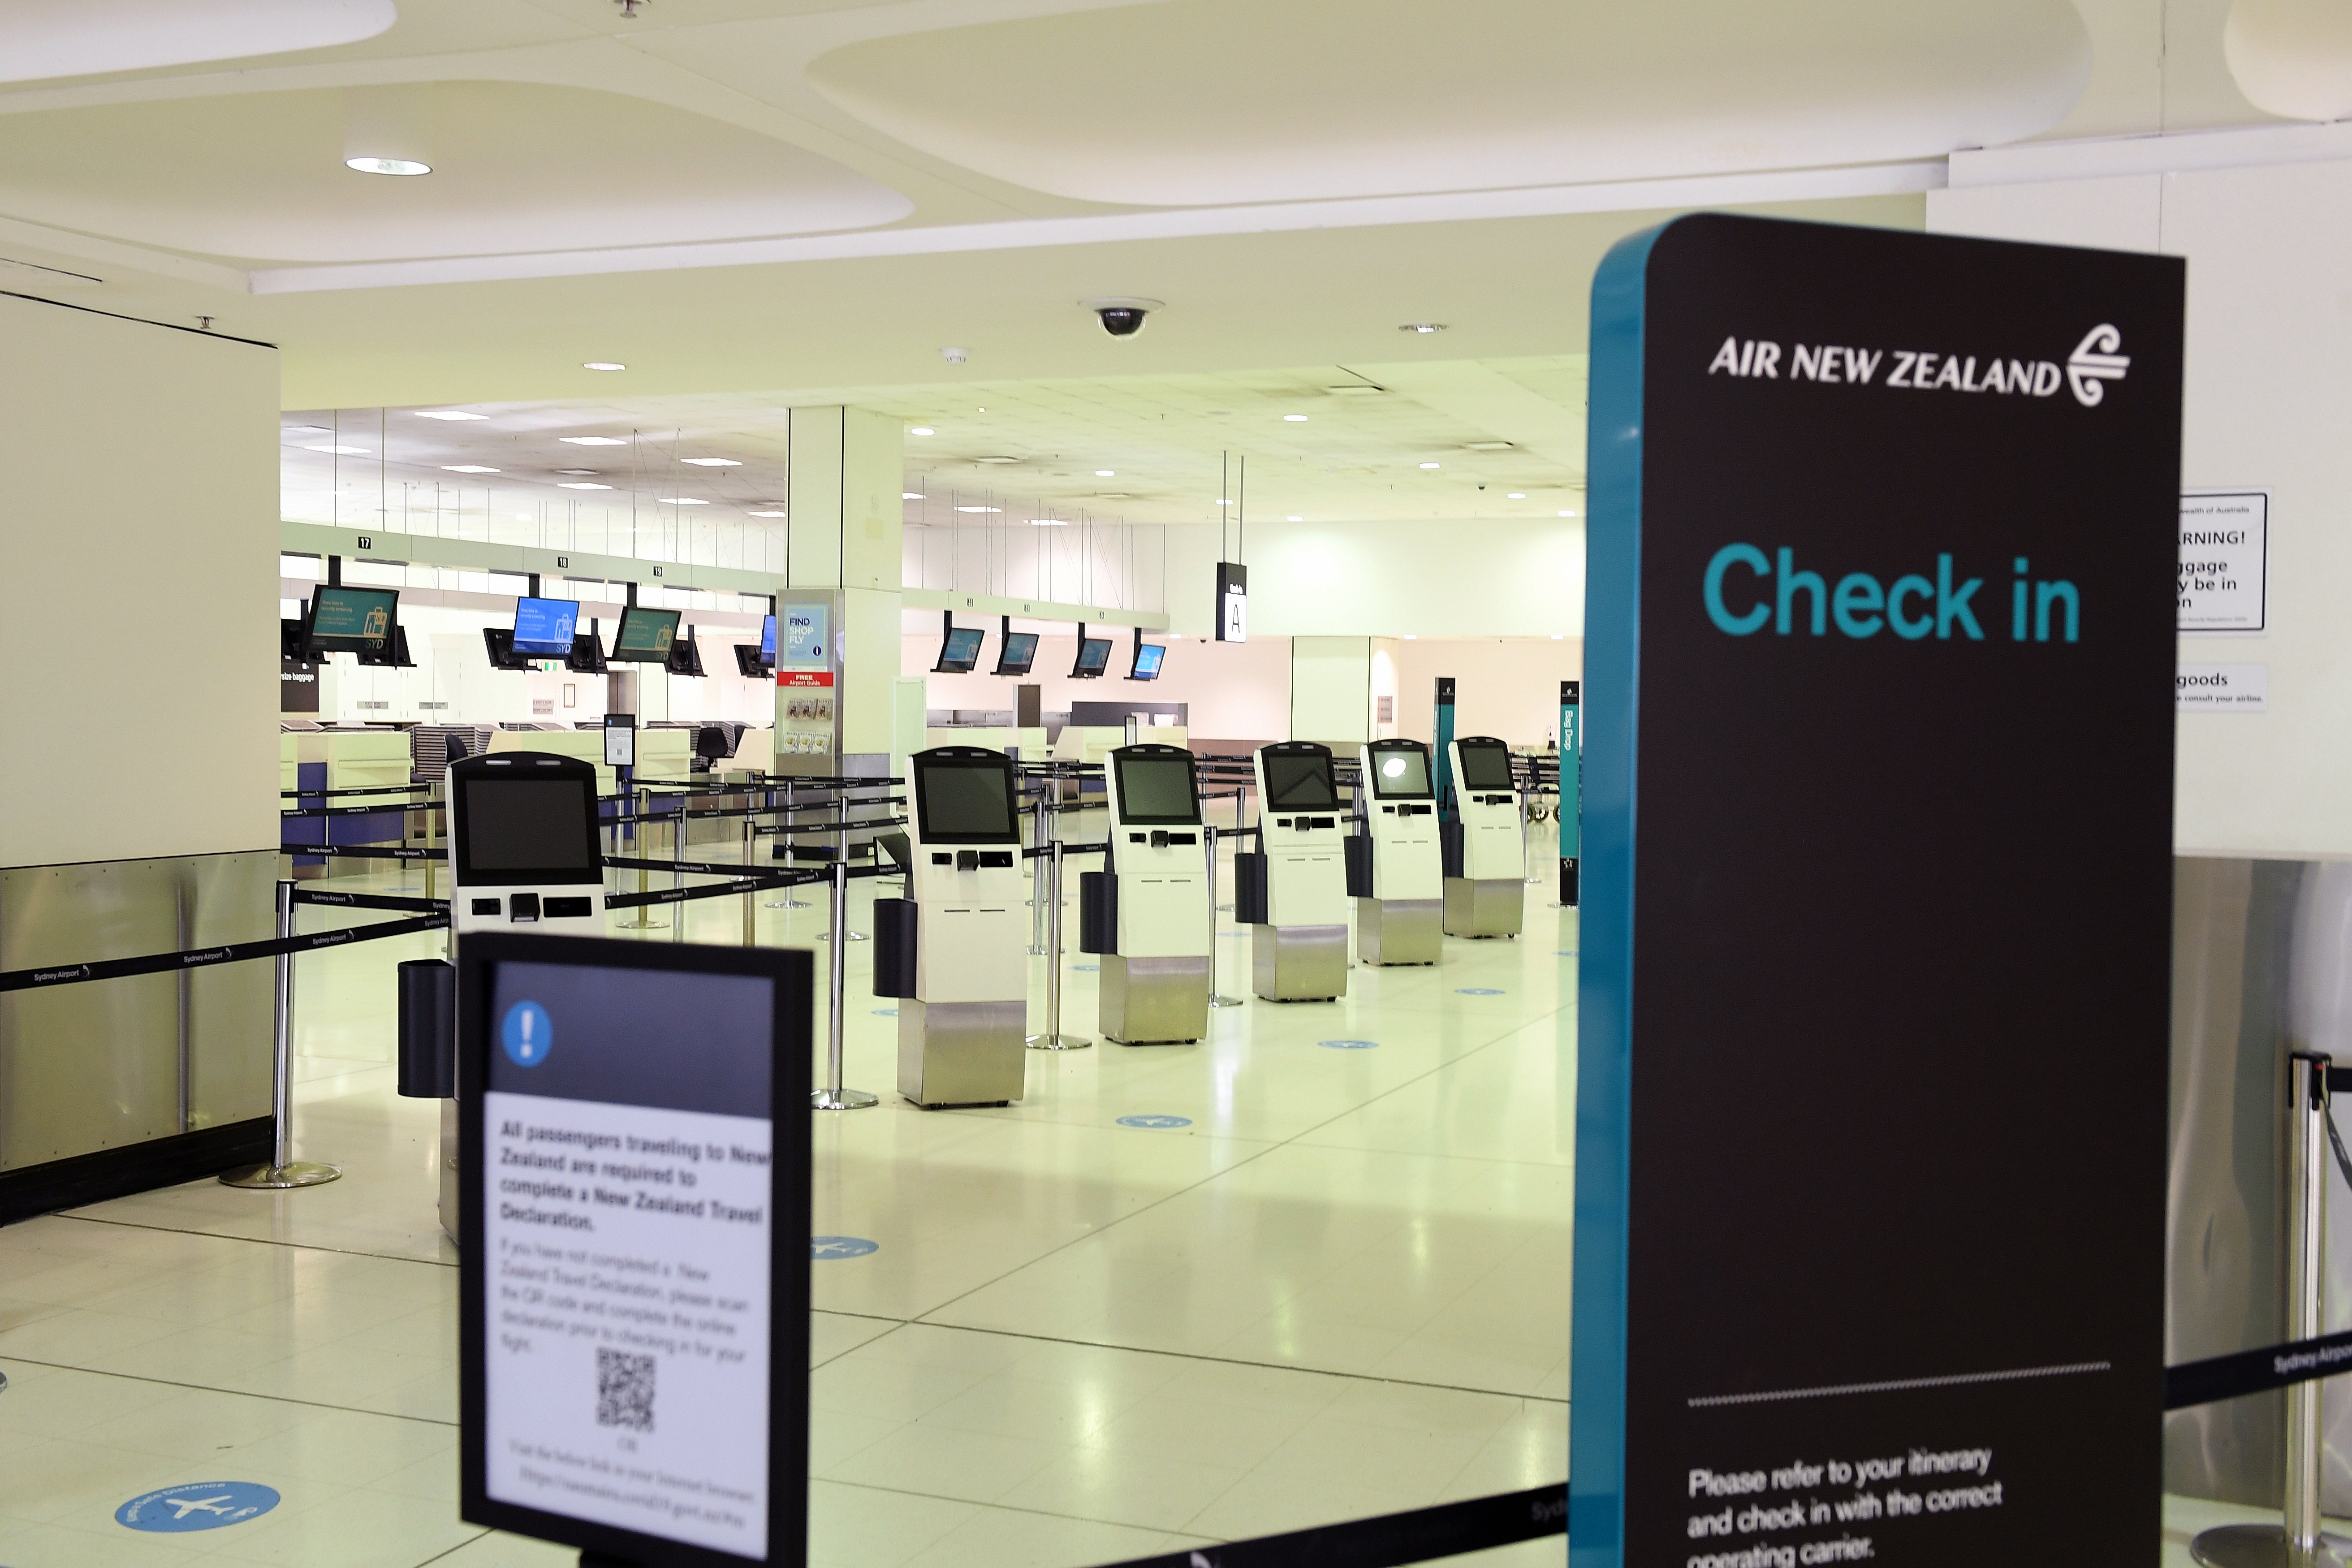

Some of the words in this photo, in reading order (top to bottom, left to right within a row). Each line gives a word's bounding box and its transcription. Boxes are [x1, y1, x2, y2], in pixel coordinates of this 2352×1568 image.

[1708, 335, 1781, 379] AIR
[1790, 342, 1882, 384] NEW
[1886, 350, 2062, 396] ZEALAND
[361, 538, 369, 548] 17
[2178, 531, 2244, 544] RNING!
[560, 558, 566, 567] 18
[655, 567, 661, 576] 19
[2195, 577, 2215, 591] be
[2222, 577, 2236, 590] in
[1703, 542, 1985, 641] Check
[2012, 557, 2079, 643] in
[790, 618, 810, 626] FIND
[1232, 604, 1240, 633] A
[790, 626, 814, 635] SHOP
[365, 639, 384, 649] SYD
[790, 635, 804, 644] FLY
[556, 644, 570, 653] SYD
[293, 672, 314, 682] baggage
[2176, 672, 2227, 689] goods
[1564, 710, 1573, 728] Bag
[1564, 729, 1573, 751] Drop
[312, 894, 329, 902] Sydney
[312, 937, 329, 945] Sydney
[330, 934, 346, 942] Airport
[184, 955, 203, 963] Sydney
[204, 952, 223, 960] Airport
[34, 972, 57, 981] Sydney
[57, 969, 79, 978] Airport
[500, 1121, 521, 1138] All
[526, 1125, 621, 1150] passengers
[706, 1141, 725, 1160] to
[729, 1144, 772, 1165] New
[500, 1147, 565, 1171] Zealand
[570, 1160, 596, 1174] are
[601, 1162, 674, 1184] required
[678, 1168, 697, 1187] to
[500, 1178, 574, 1200] complete
[579, 1187, 588, 1202] a
[593, 1187, 629, 1206] New
[634, 1190, 704, 1217] Zealand
[710, 1200, 764, 1223] Travel
[499, 1202, 594, 1231] Declaration.
[2274, 1353, 2317, 1374] Sydney
[1689, 1468, 1766, 1498] Please
[1772, 1460, 1823, 1488] refer
[1828, 1459, 1851, 1484] to
[1855, 1455, 1904, 1488] your
[1908, 1447, 1992, 1476] itinerary
[1687, 1507, 1732, 1538] and
[1738, 1500, 1806, 1533] check
[1811, 1497, 1831, 1523] in
[1836, 1491, 1881, 1522] with
[1886, 1489, 1922, 1516] the
[1926, 1481, 2002, 1512] correct
[1687, 1542, 1795, 1568] operating
[1800, 1533, 1875, 1564] carrier.
